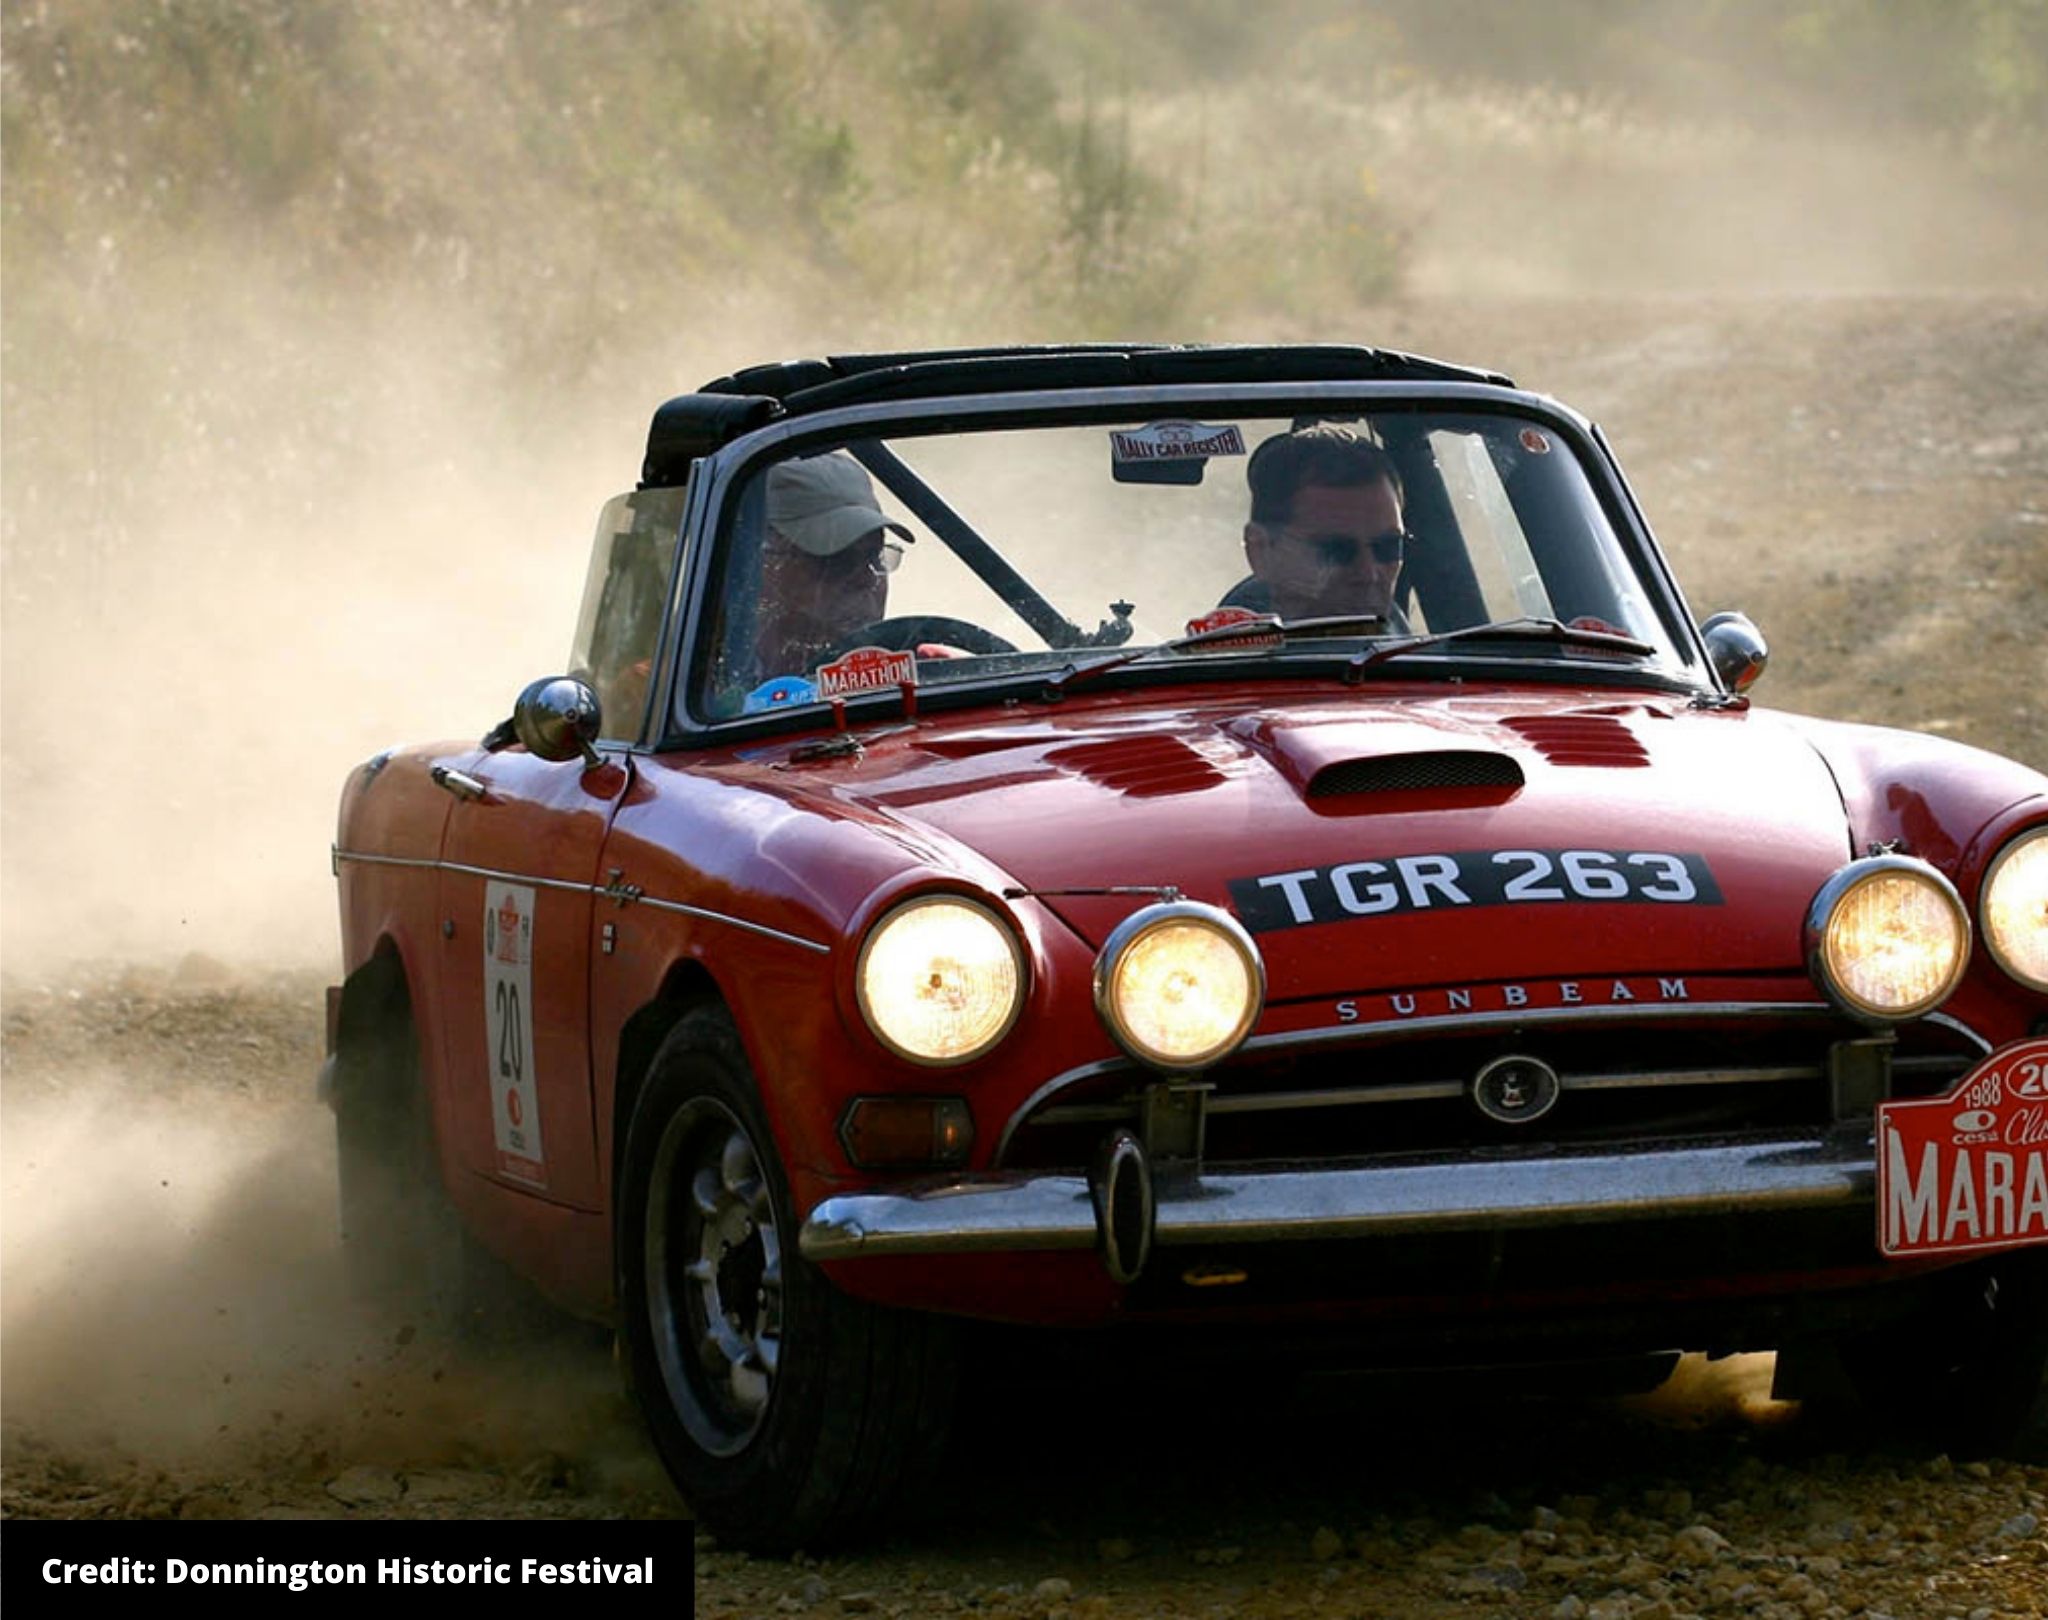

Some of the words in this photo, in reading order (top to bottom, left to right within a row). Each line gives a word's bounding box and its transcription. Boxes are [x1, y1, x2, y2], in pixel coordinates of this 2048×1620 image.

[1115, 434, 1154, 459] RALLY
[1157, 442, 1181, 456] CAR
[1183, 428, 1240, 456] REGISTER
[822, 657, 911, 695] MARATHON
[1258, 854, 1473, 925] TGR
[1491, 850, 1698, 903] 263
[1335, 977, 1690, 1023] SUNBEAM
[496, 979, 523, 1083] 20
[1963, 1072, 2002, 1109] 1988
[1888, 1128, 2048, 1247] MARA
